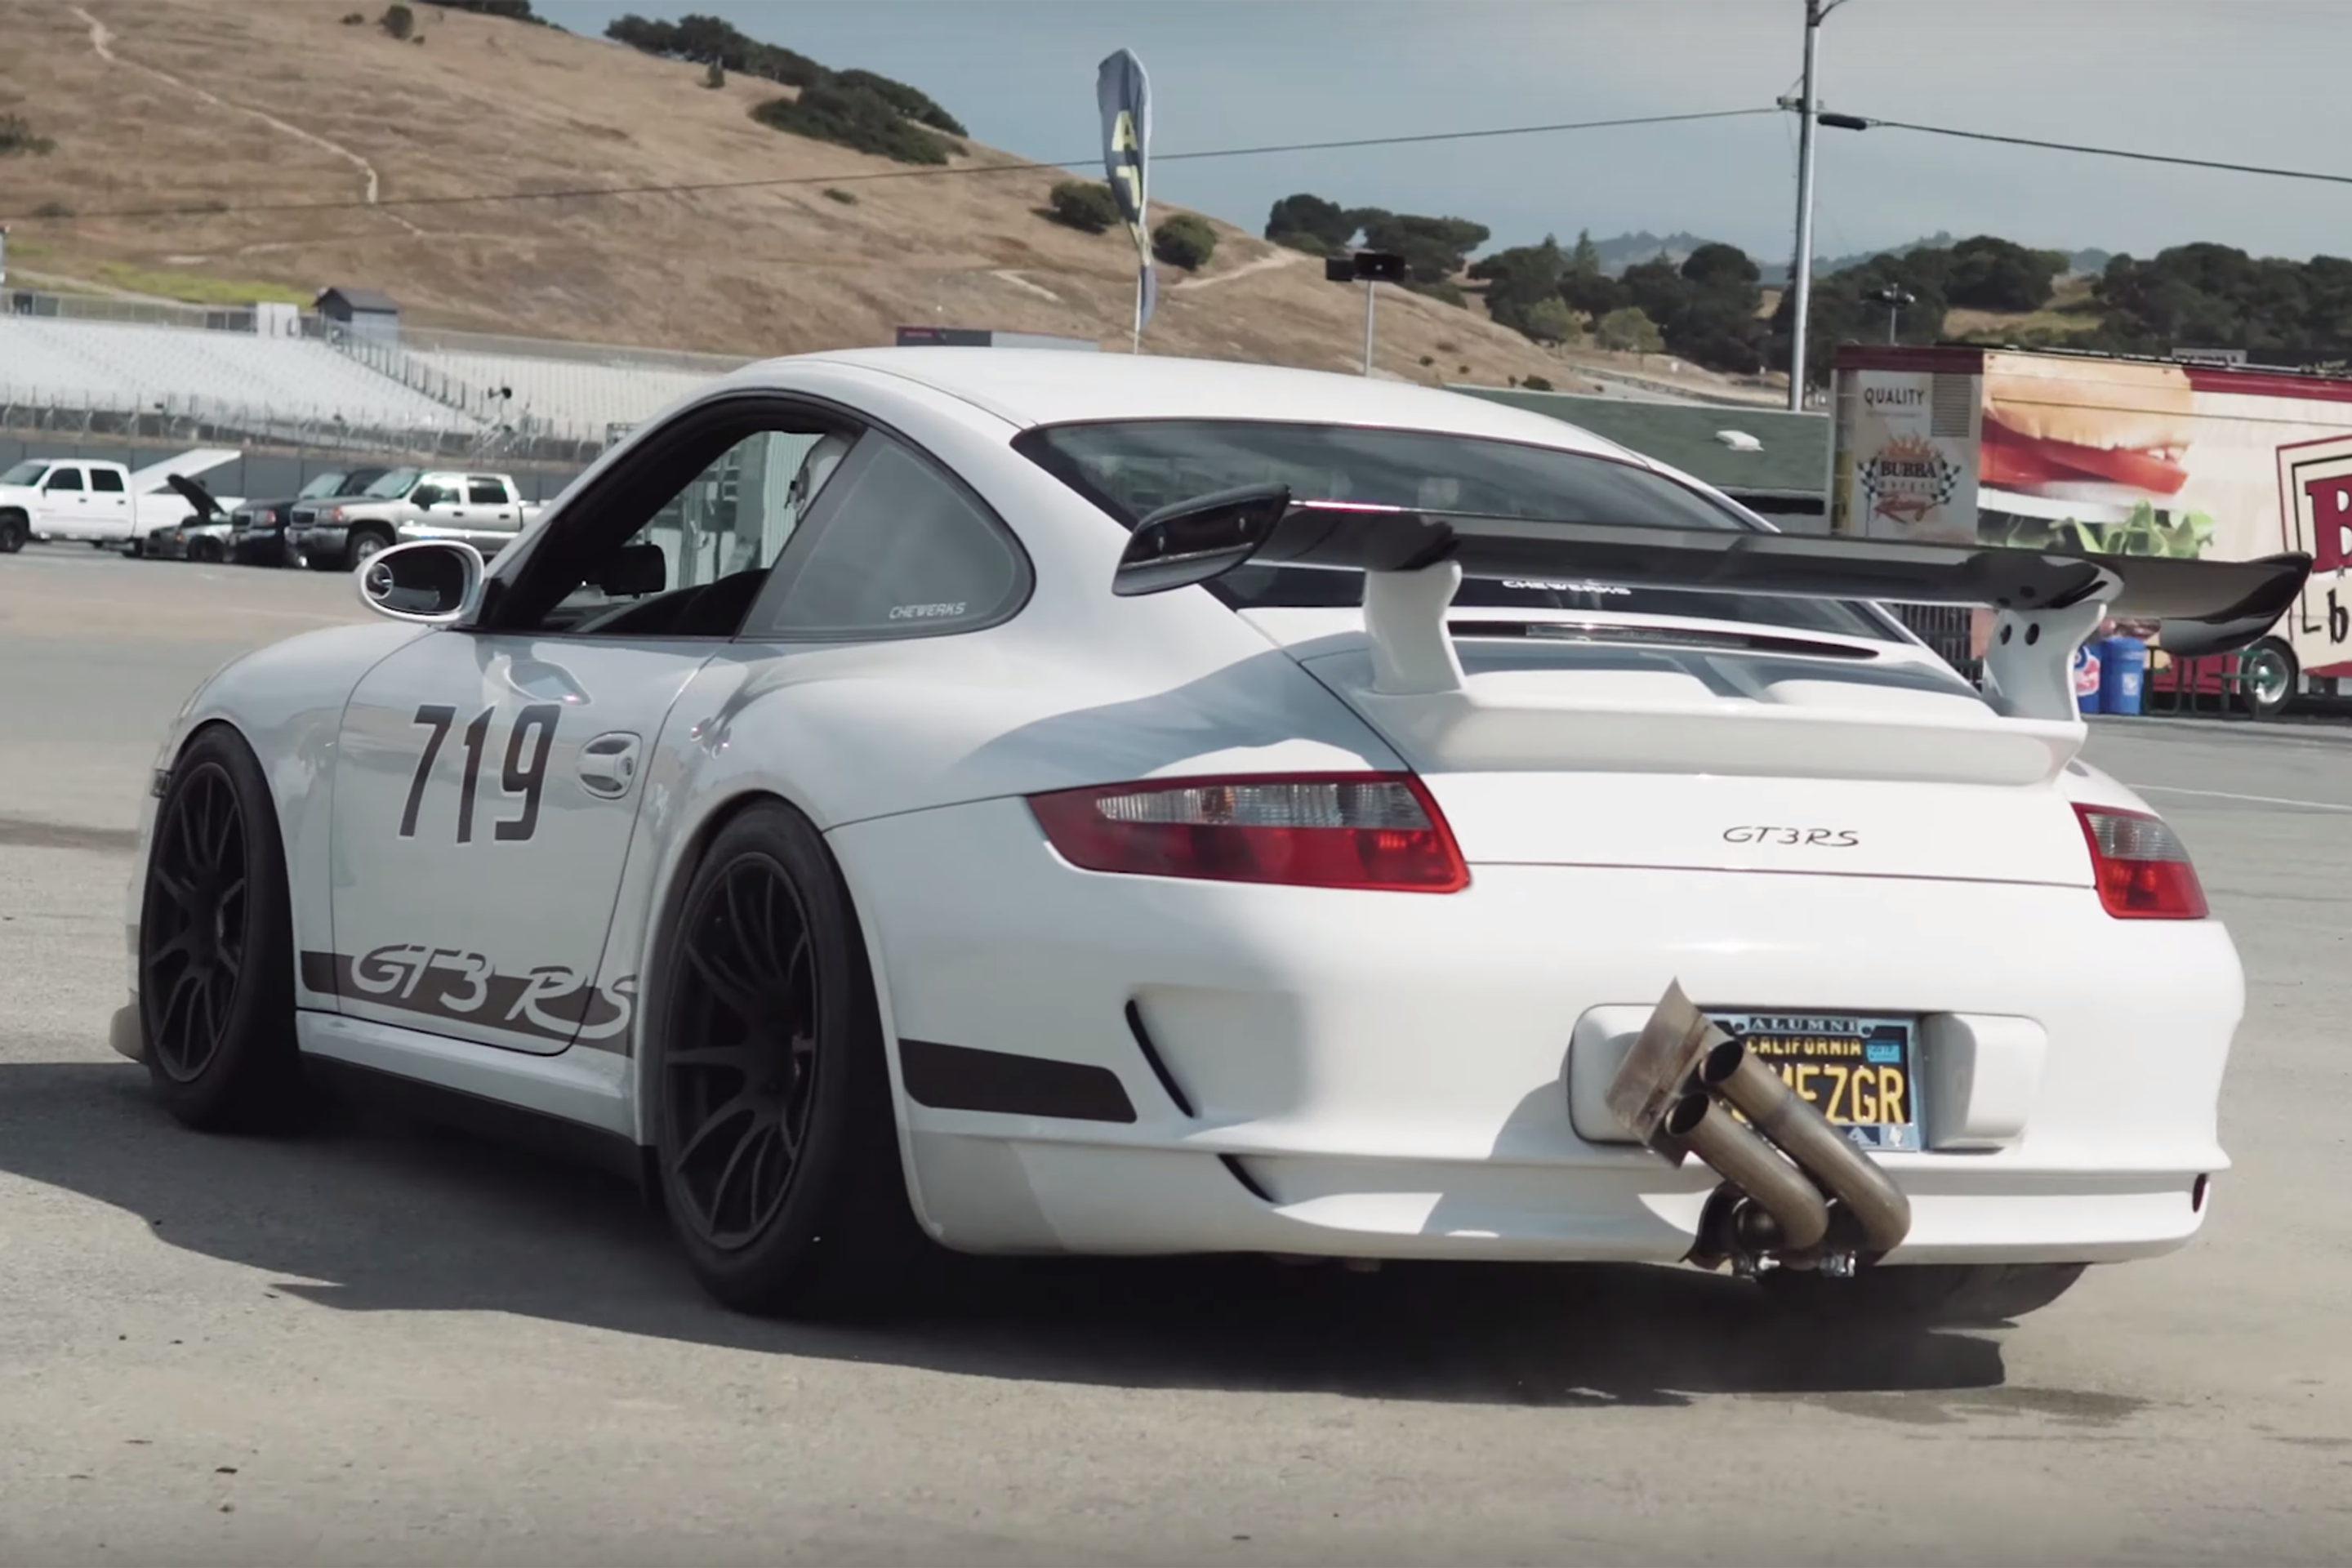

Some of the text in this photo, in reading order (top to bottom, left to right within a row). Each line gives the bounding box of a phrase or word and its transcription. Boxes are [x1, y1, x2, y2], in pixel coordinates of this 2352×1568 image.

[1864, 387, 1924, 407] QUALITY
[1880, 461, 1937, 479] BUBBA
[889, 602, 967, 619] CHEWERKS
[399, 702, 562, 844] 719
[351, 943, 638, 1040] GT3 RS
[1750, 1017, 1858, 1032] ALUMNI
[1746, 1036, 1862, 1056] CALIFORNIA
